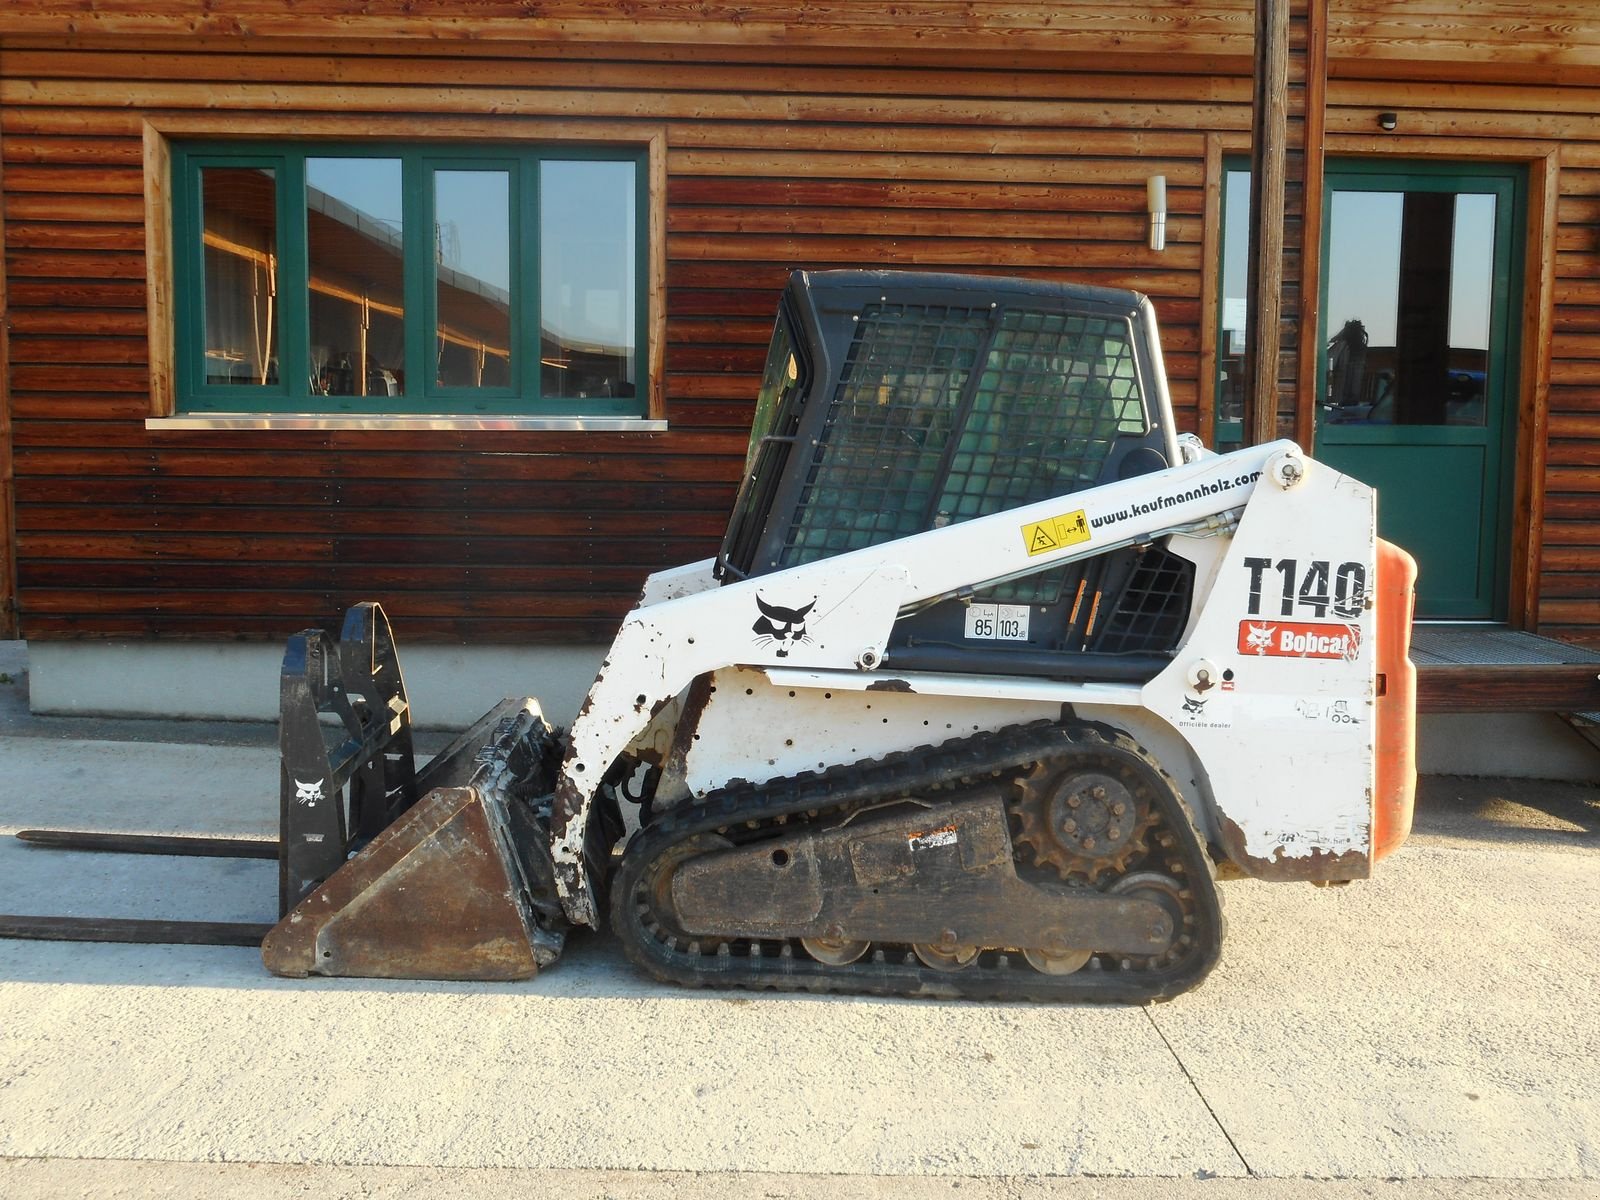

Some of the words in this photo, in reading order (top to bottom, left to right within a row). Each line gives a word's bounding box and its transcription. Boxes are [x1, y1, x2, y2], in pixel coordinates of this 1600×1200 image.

[1243, 557, 1365, 619] T140
[975, 619, 993, 636] 85
[1000, 619, 1019, 637] 103
[1280, 630, 1349, 654] Bobcat
